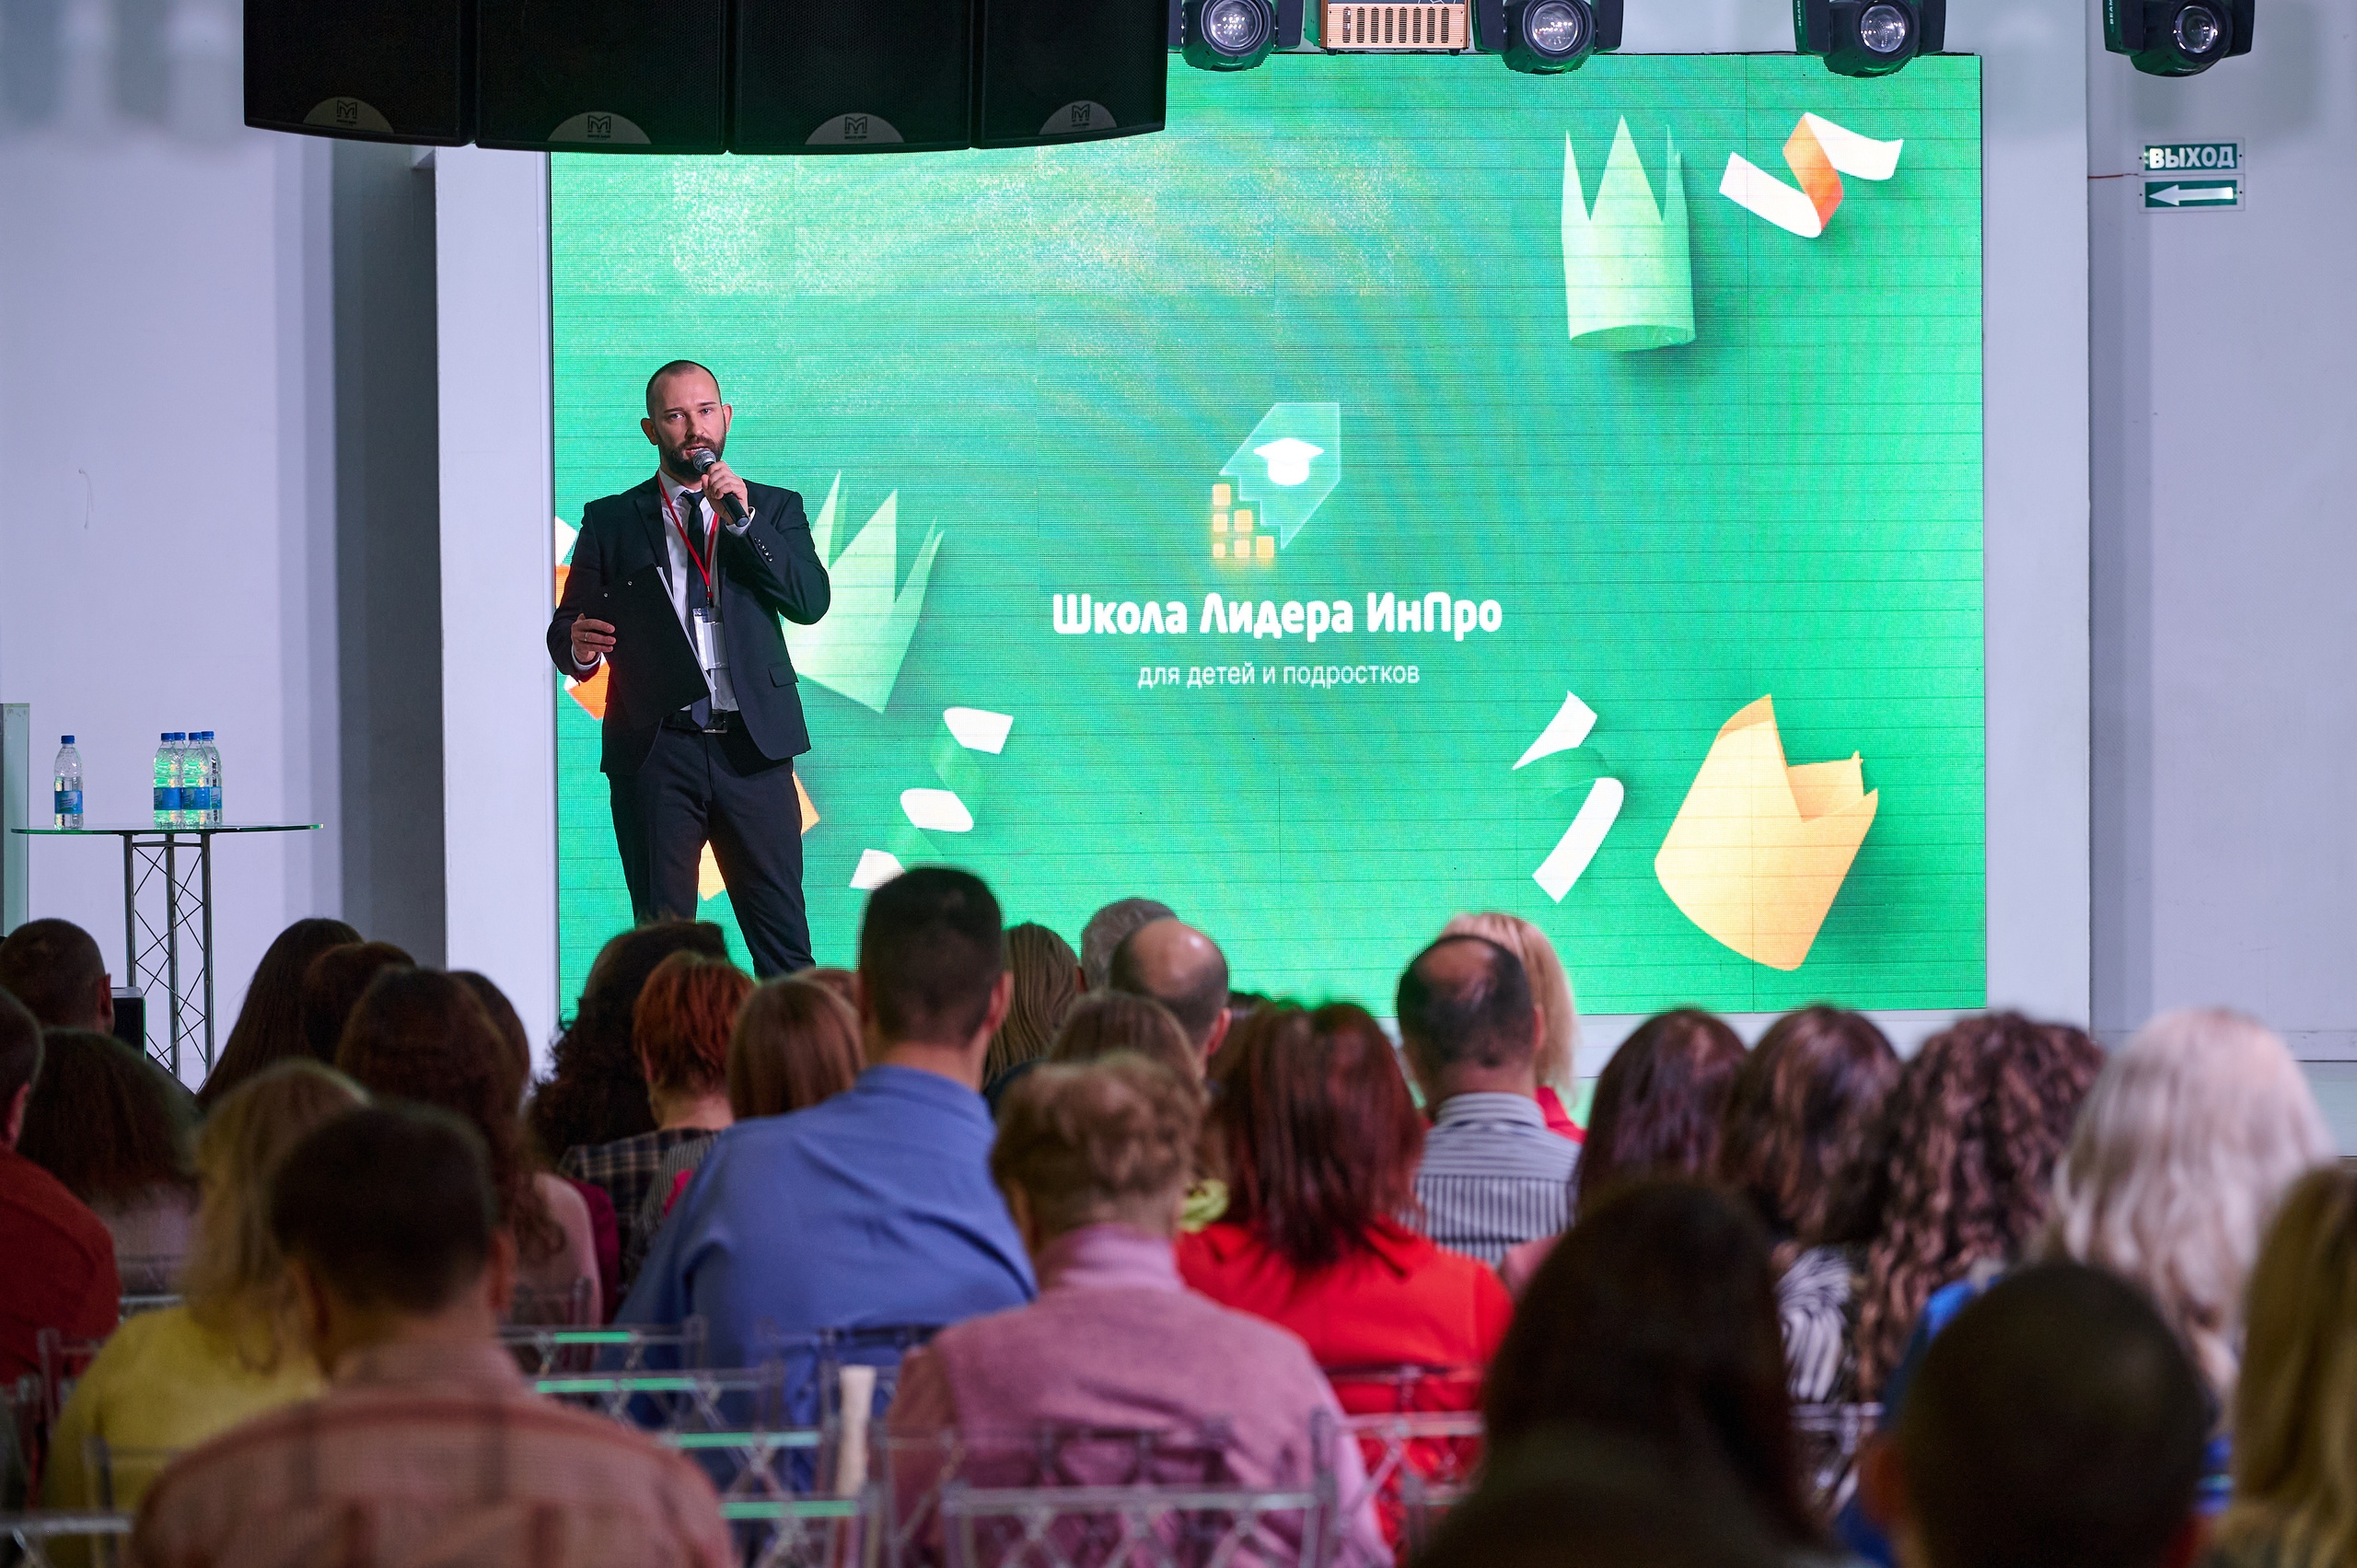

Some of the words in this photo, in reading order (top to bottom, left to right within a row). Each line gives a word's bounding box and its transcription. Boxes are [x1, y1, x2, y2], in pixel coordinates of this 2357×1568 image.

[2149, 146, 2235, 168] ВЫХОД
[1052, 593, 1188, 634] Школа
[1199, 592, 1353, 643] Лидера
[1367, 591, 1503, 642] ИнПро
[1138, 667, 1180, 689] для
[1187, 661, 1255, 689] детей
[1262, 666, 1276, 684] и
[1283, 665, 1421, 689] подростков
